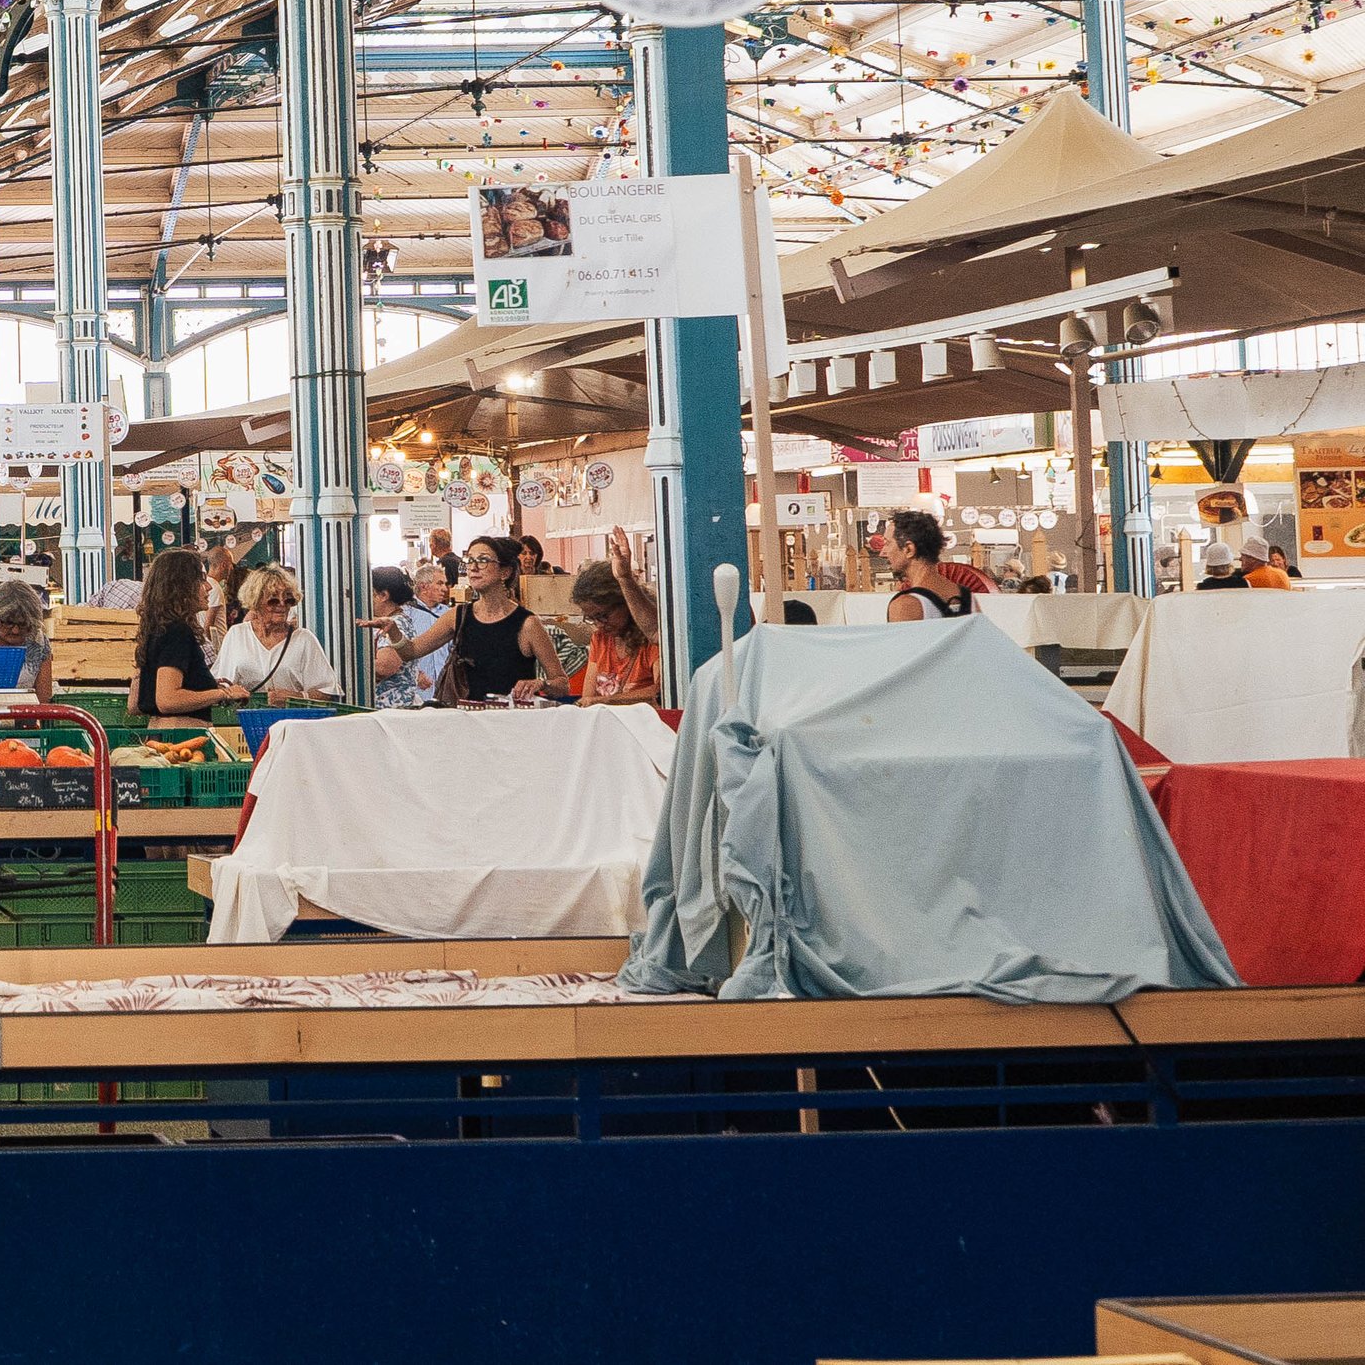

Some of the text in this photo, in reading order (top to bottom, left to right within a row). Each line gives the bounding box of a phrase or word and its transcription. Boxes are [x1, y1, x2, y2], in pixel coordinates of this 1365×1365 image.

[570, 184, 665, 198] BOULANGERIE
[579, 214, 662, 225] DU CHEVAL GRIS
[624, 234, 644, 242] Tille
[491, 285, 523, 309] AB
